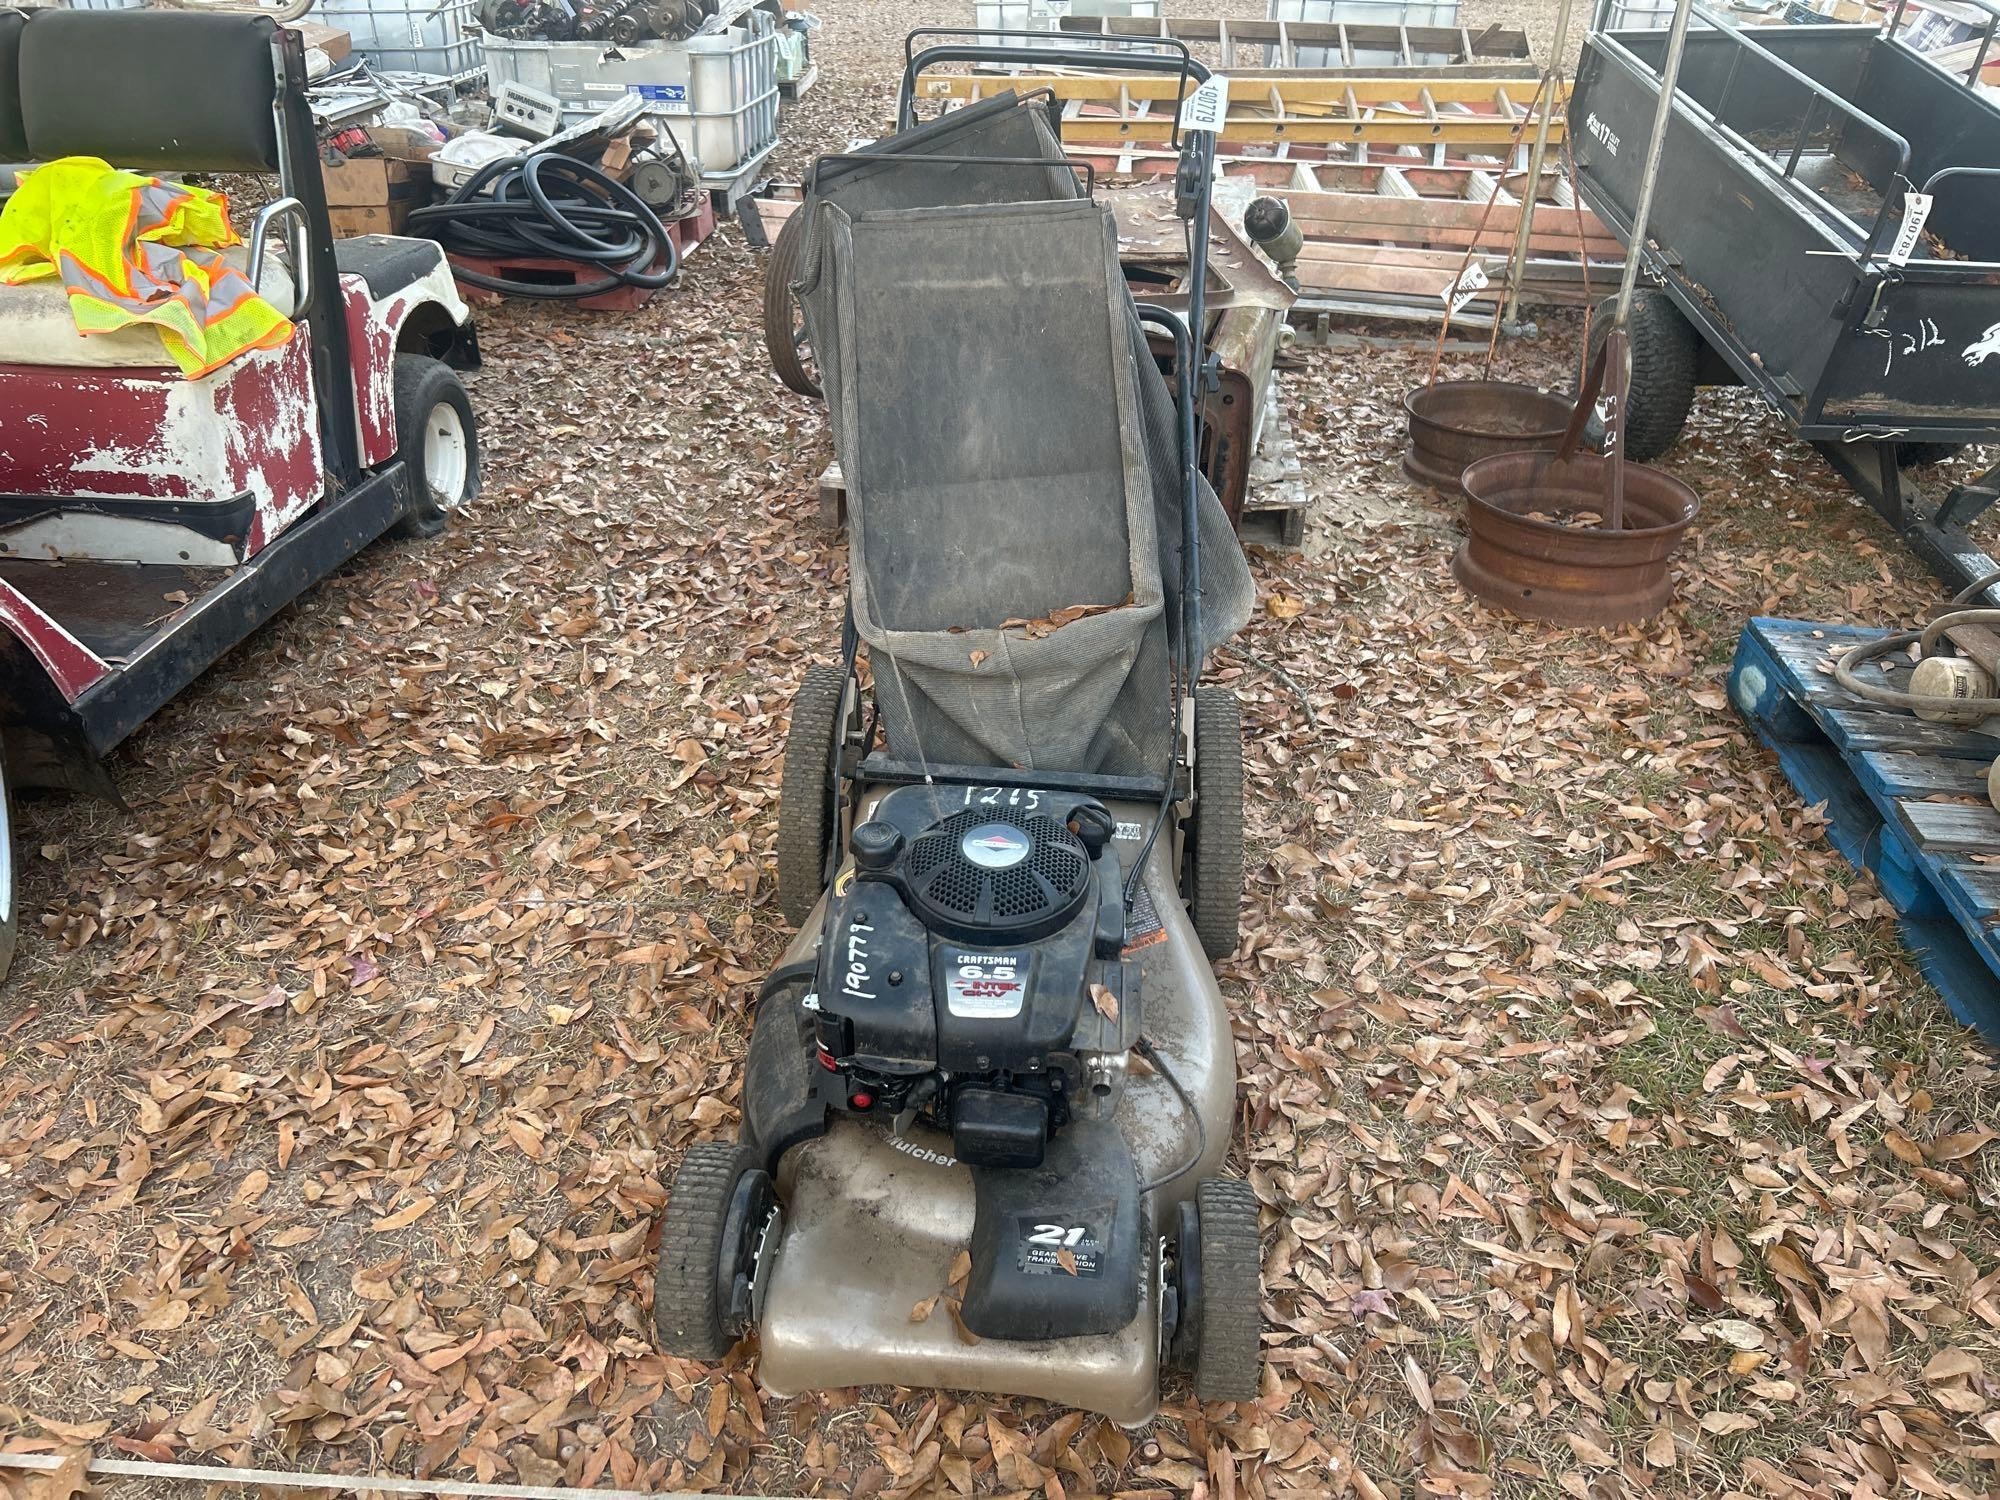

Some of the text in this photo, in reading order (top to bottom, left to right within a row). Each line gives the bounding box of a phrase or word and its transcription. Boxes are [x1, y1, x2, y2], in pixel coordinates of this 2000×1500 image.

[507, 90, 553, 114] HUMMINBIRD
[1196, 86, 1219, 123] 190779
[1898, 209, 1924, 257] 190783
[842, 923, 877, 999] 190779
[957, 955, 1017, 966] CRAFTSMAN
[959, 965, 1016, 980] 6.5
[972, 981, 1022, 992] INTEK
[1028, 1224, 1086, 1247] 21
